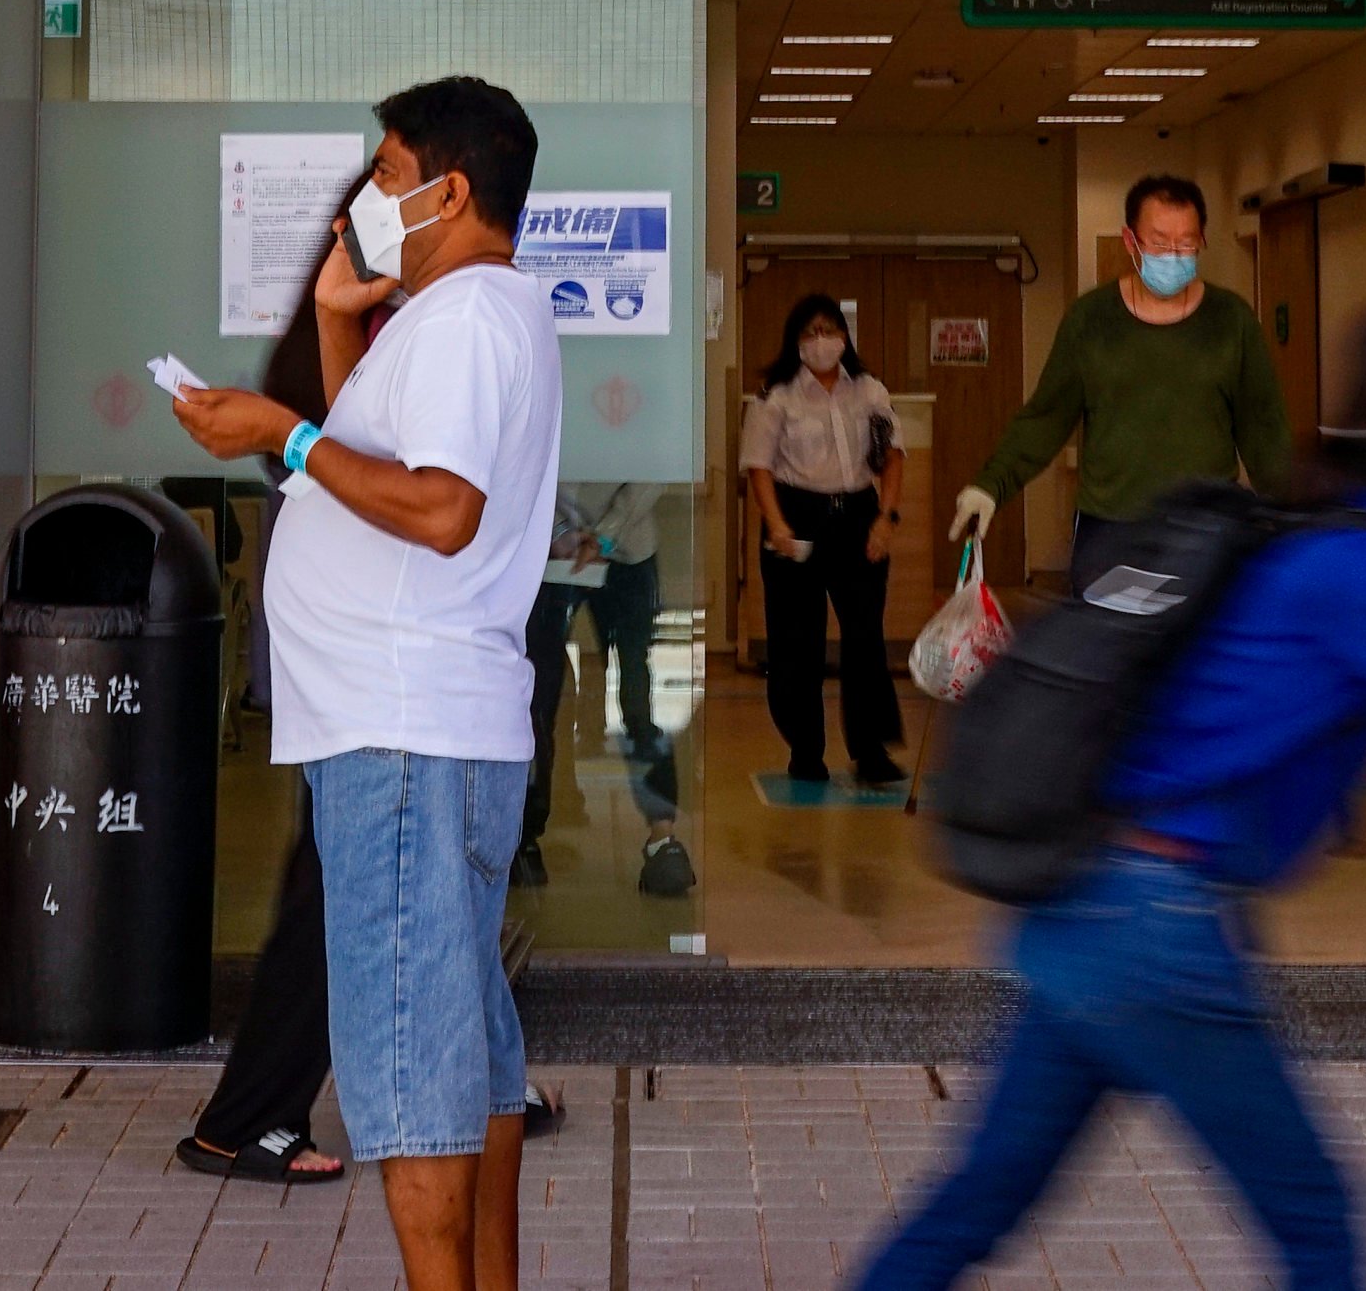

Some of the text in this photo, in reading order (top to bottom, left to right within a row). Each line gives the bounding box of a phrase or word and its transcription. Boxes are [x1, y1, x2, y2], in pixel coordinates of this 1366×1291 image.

[1233, 0, 1289, 15] Registration
[1291, 1, 1328, 13] Counter
[757, 180, 773, 206] 2
[525, 205, 618, 235] 戒備
[40, 883, 58, 916] 4
